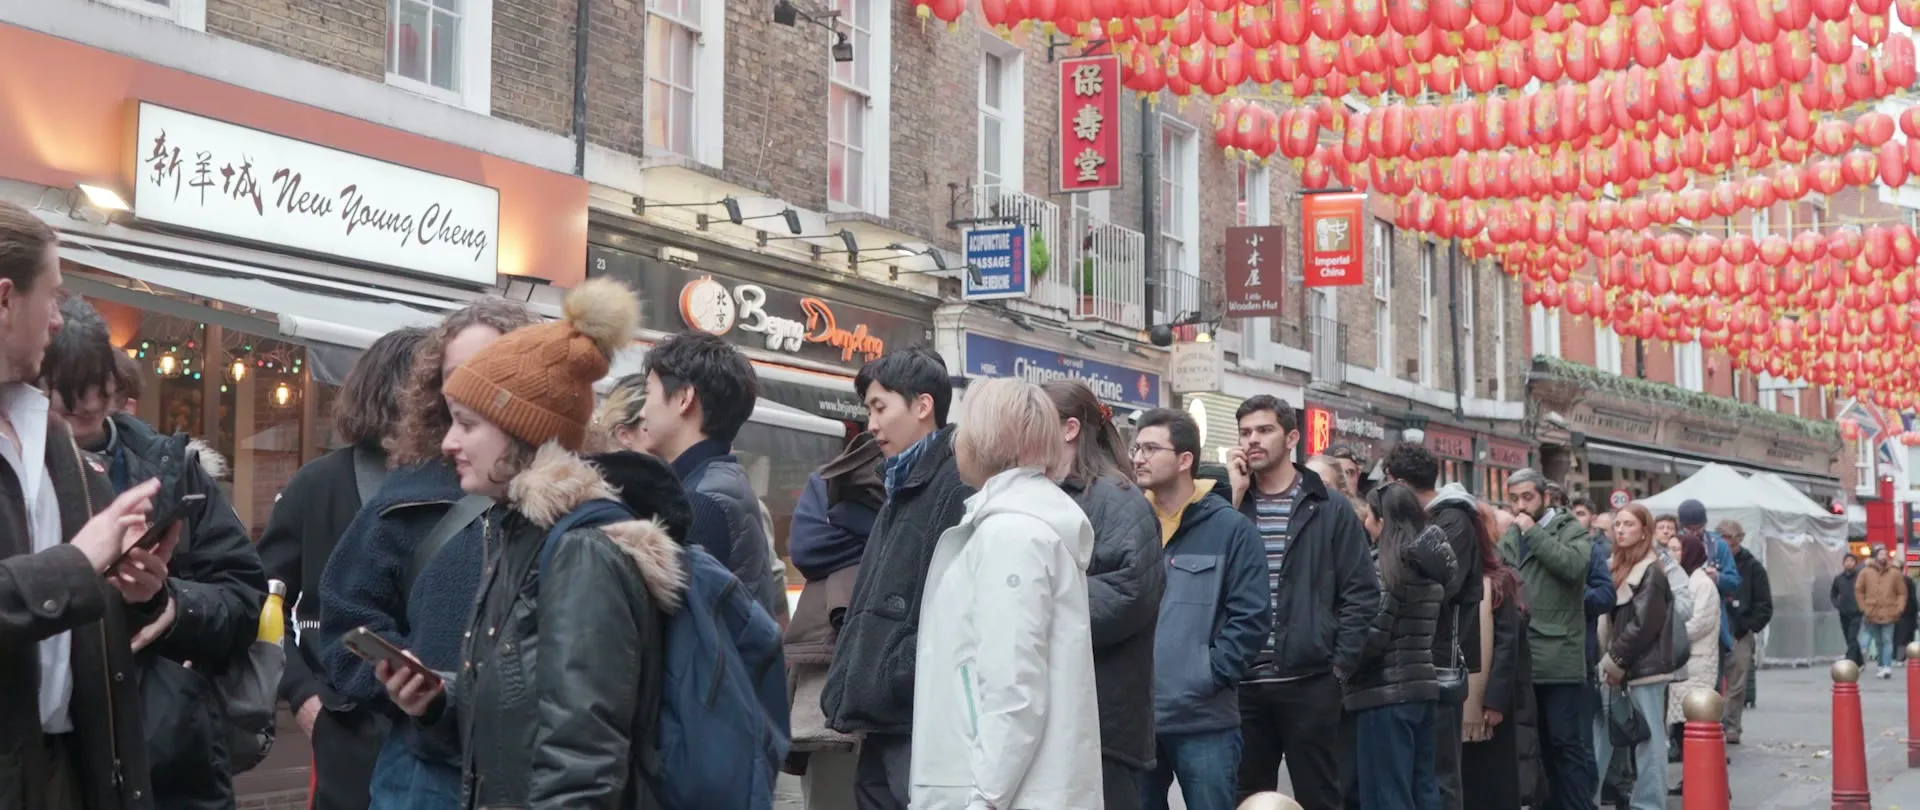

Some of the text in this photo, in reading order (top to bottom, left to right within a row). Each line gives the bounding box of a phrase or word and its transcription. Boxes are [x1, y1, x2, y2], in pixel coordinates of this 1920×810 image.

[1070, 64, 1105, 182] 保壽堂
[144, 127, 263, 217] 新羊城
[272, 168, 488, 262] New Young Cheng
[968, 232, 1010, 252] ACUPUNCTURE
[596, 258, 606, 270] 23
[1244, 233, 1264, 287] 小木屋
[1314, 255, 1351, 268] Imperial
[1320, 267, 1346, 278] China
[716, 287, 727, 328] 北京
[1228, 300, 1278, 311] Wooden Hut
[1614, 494, 1627, 504] 20
